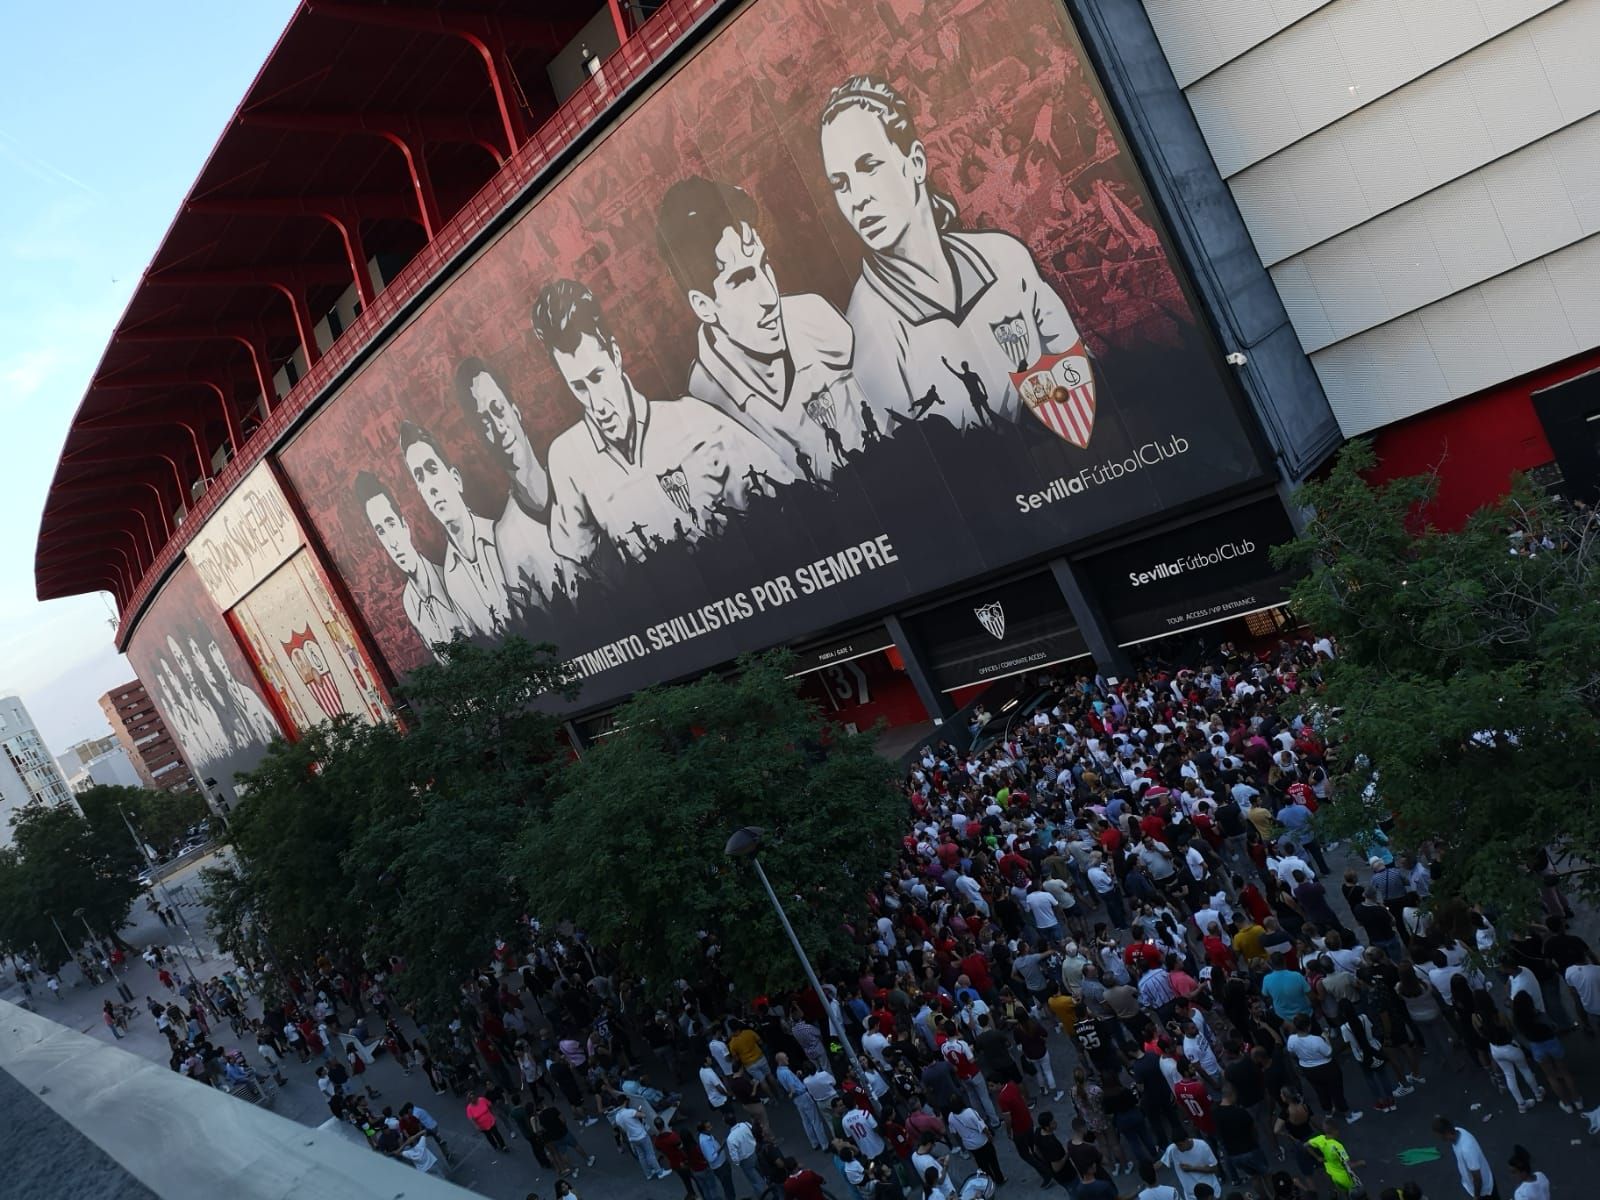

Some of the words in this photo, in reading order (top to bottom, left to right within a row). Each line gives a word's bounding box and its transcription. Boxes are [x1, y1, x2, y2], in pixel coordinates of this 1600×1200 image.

[1015, 434, 1190, 514] SevillaFútbolClub
[1129, 538, 1256, 587] SevillaFútbolClub
[645, 592, 754, 651] SEVILLISTAS
[751, 575, 798, 613] POR
[795, 533, 899, 595] SIEMPRE
[1166, 615, 1184, 625] TOUR
[1186, 608, 1209, 621] ACCESS
[1222, 596, 1257, 612] ENTRANCE
[978, 664, 998, 675] OFFICES
[1000, 657, 1029, 669] CORPORATE
[1028, 651, 1047, 662] ACCESS
[1078, 1030, 1101, 1050] 25
[1183, 1098, 1205, 1118] 10
[849, 1122, 867, 1140] 10
